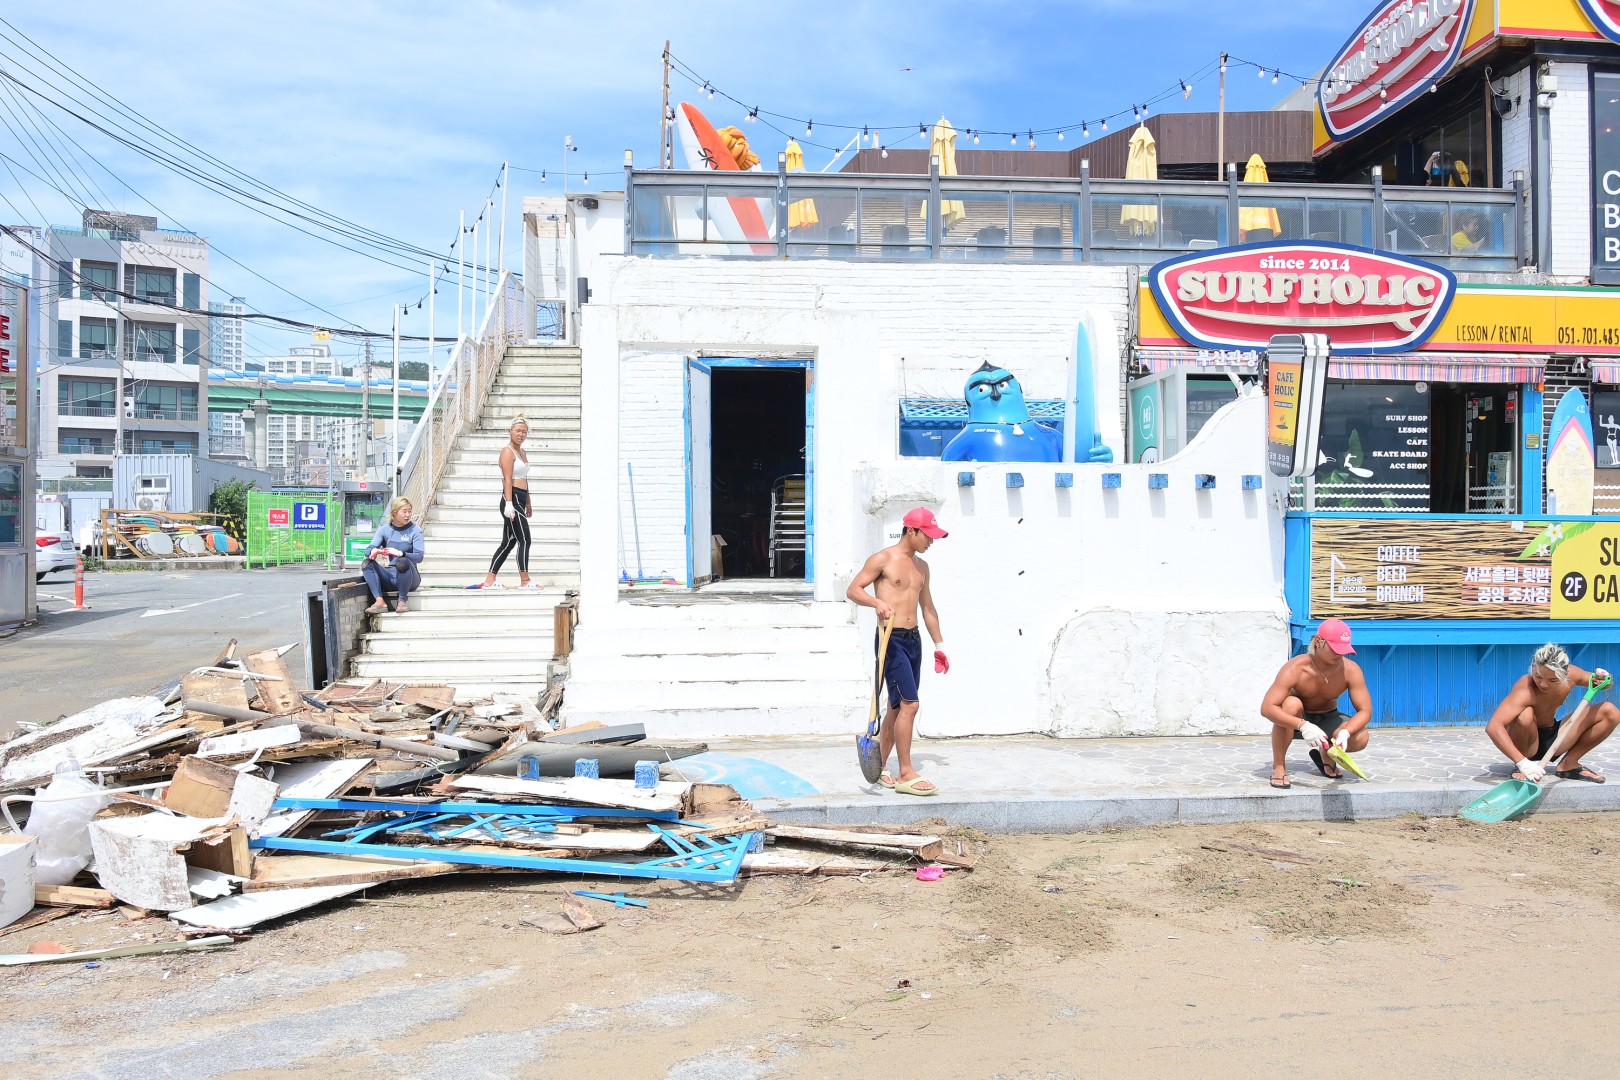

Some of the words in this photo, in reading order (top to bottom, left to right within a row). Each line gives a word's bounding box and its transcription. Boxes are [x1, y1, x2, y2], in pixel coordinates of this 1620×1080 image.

[1260, 255, 1305, 269] since
[1309, 258, 1351, 272] 2014
[1176, 270, 1436, 307] SURFHOLIC
[1276, 372, 1294, 383] CAFE
[1274, 385, 1295, 396] HOLIC
[305, 506, 314, 519] P
[1377, 545, 1421, 562] COFFEE
[1377, 566, 1407, 582] BEER
[1464, 566, 1519, 583] 서프홀릭
[1522, 567, 1550, 584] 뒷편
[1376, 585, 1424, 602] BRUNCH
[1478, 586, 1505, 603] 공영
[1508, 587, 1550, 603] 주차장
[1565, 577, 1583, 597] 2F
